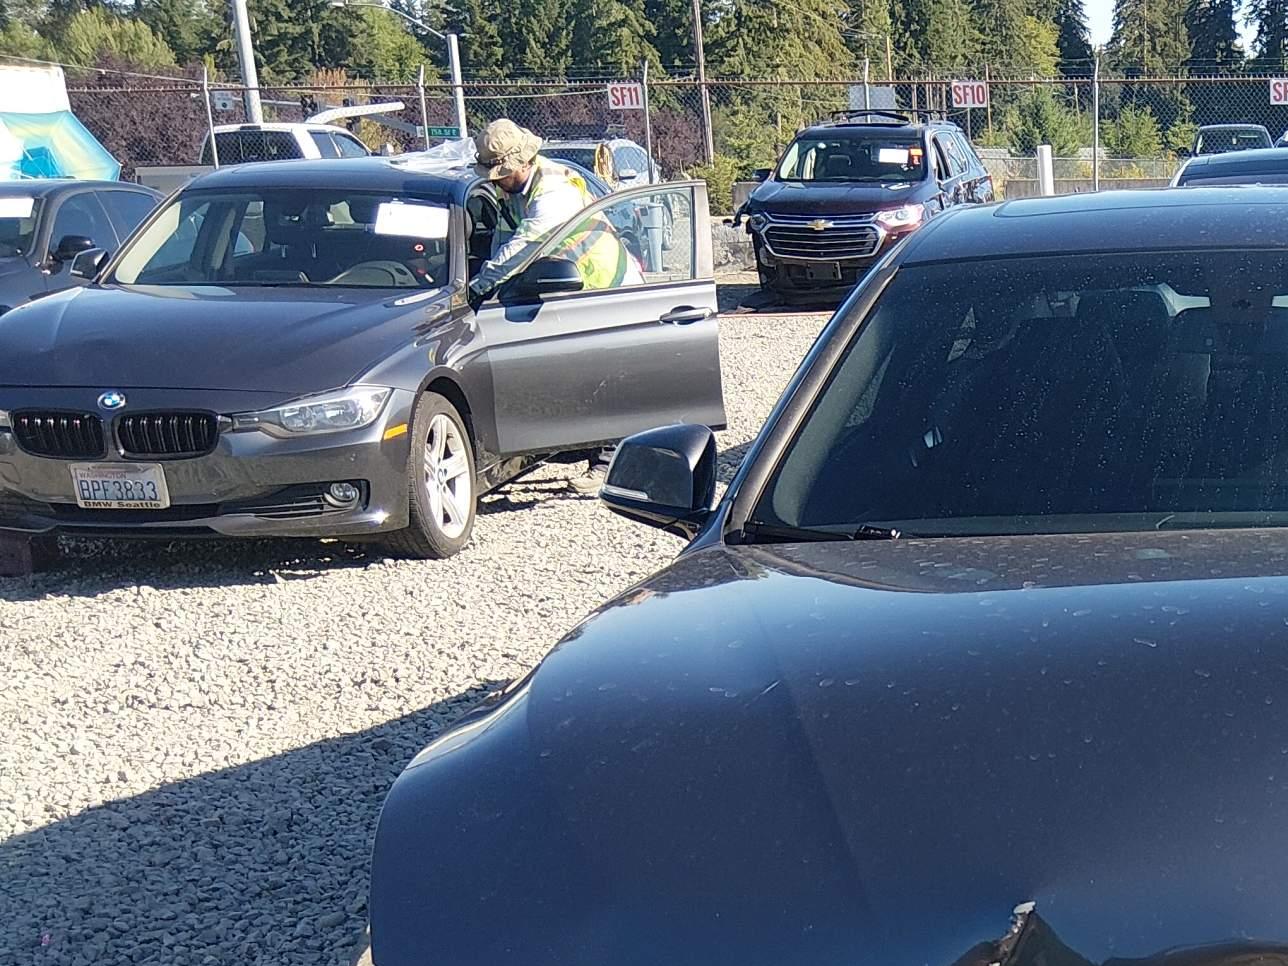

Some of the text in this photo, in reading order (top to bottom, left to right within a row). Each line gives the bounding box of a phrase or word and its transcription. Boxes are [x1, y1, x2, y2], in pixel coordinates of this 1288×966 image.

[610, 86, 640, 106] SF11
[953, 84, 986, 105] SF10
[79, 480, 158, 501] BPF3833
[83, 500, 161, 508] BMW Seattle
